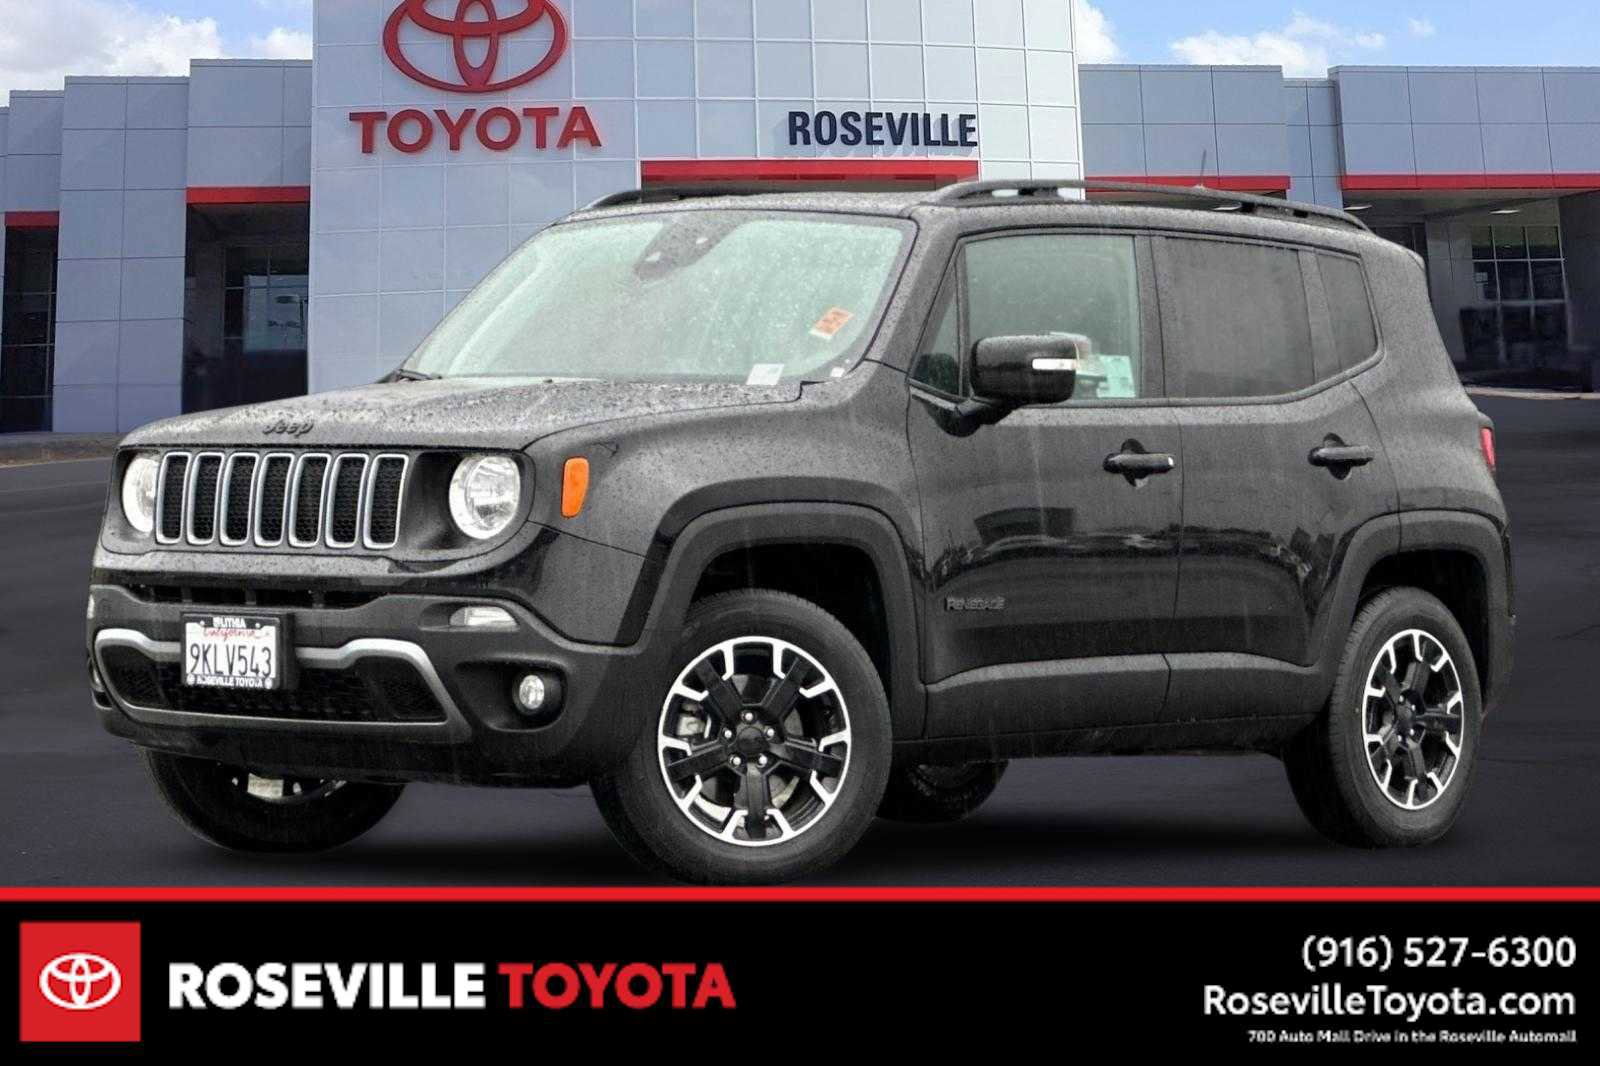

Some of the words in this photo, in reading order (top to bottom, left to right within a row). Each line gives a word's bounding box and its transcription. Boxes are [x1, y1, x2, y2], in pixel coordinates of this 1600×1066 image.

[349, 106, 602, 154] TOYOTA
[788, 110, 978, 147] ROSEVILLE
[262, 419, 314, 438] Jeep
[190, 643, 272, 677] 9KLV543
